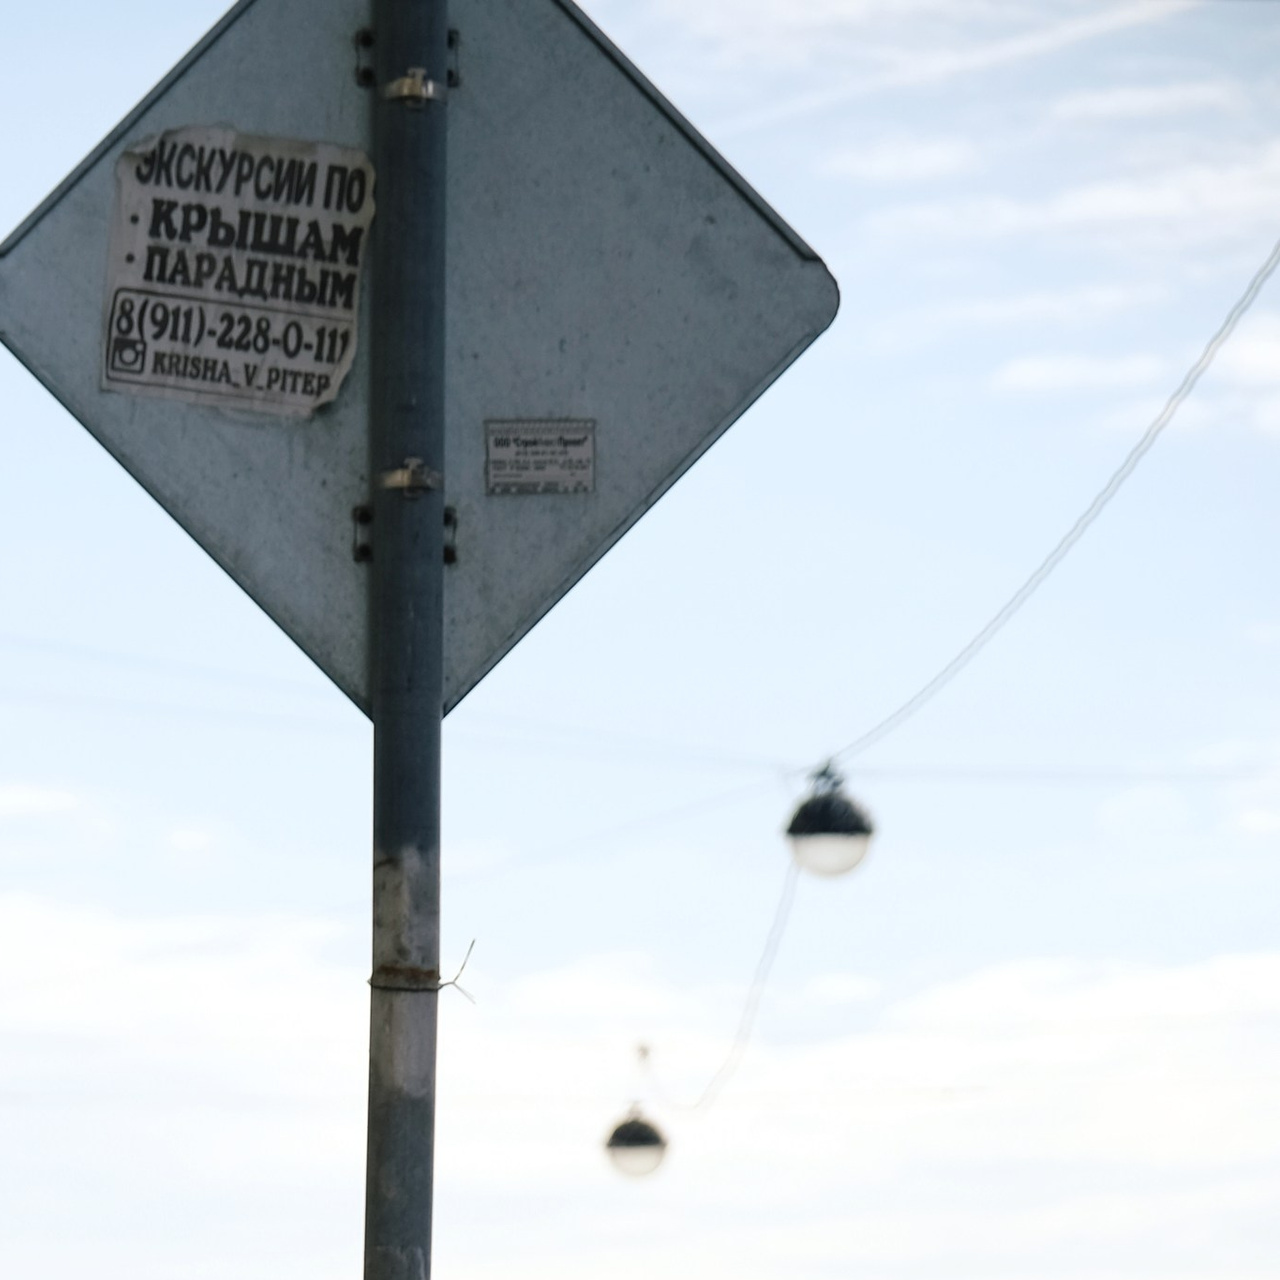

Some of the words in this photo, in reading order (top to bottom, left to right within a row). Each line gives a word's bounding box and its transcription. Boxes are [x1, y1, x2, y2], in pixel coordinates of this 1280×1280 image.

[135, 139, 317, 207] ЭКСКУРСИИ
[323, 164, 367, 214] ПО
[148, 198, 365, 267] КРЫШАМ
[143, 245, 358, 310] ПАРАДНЫМ
